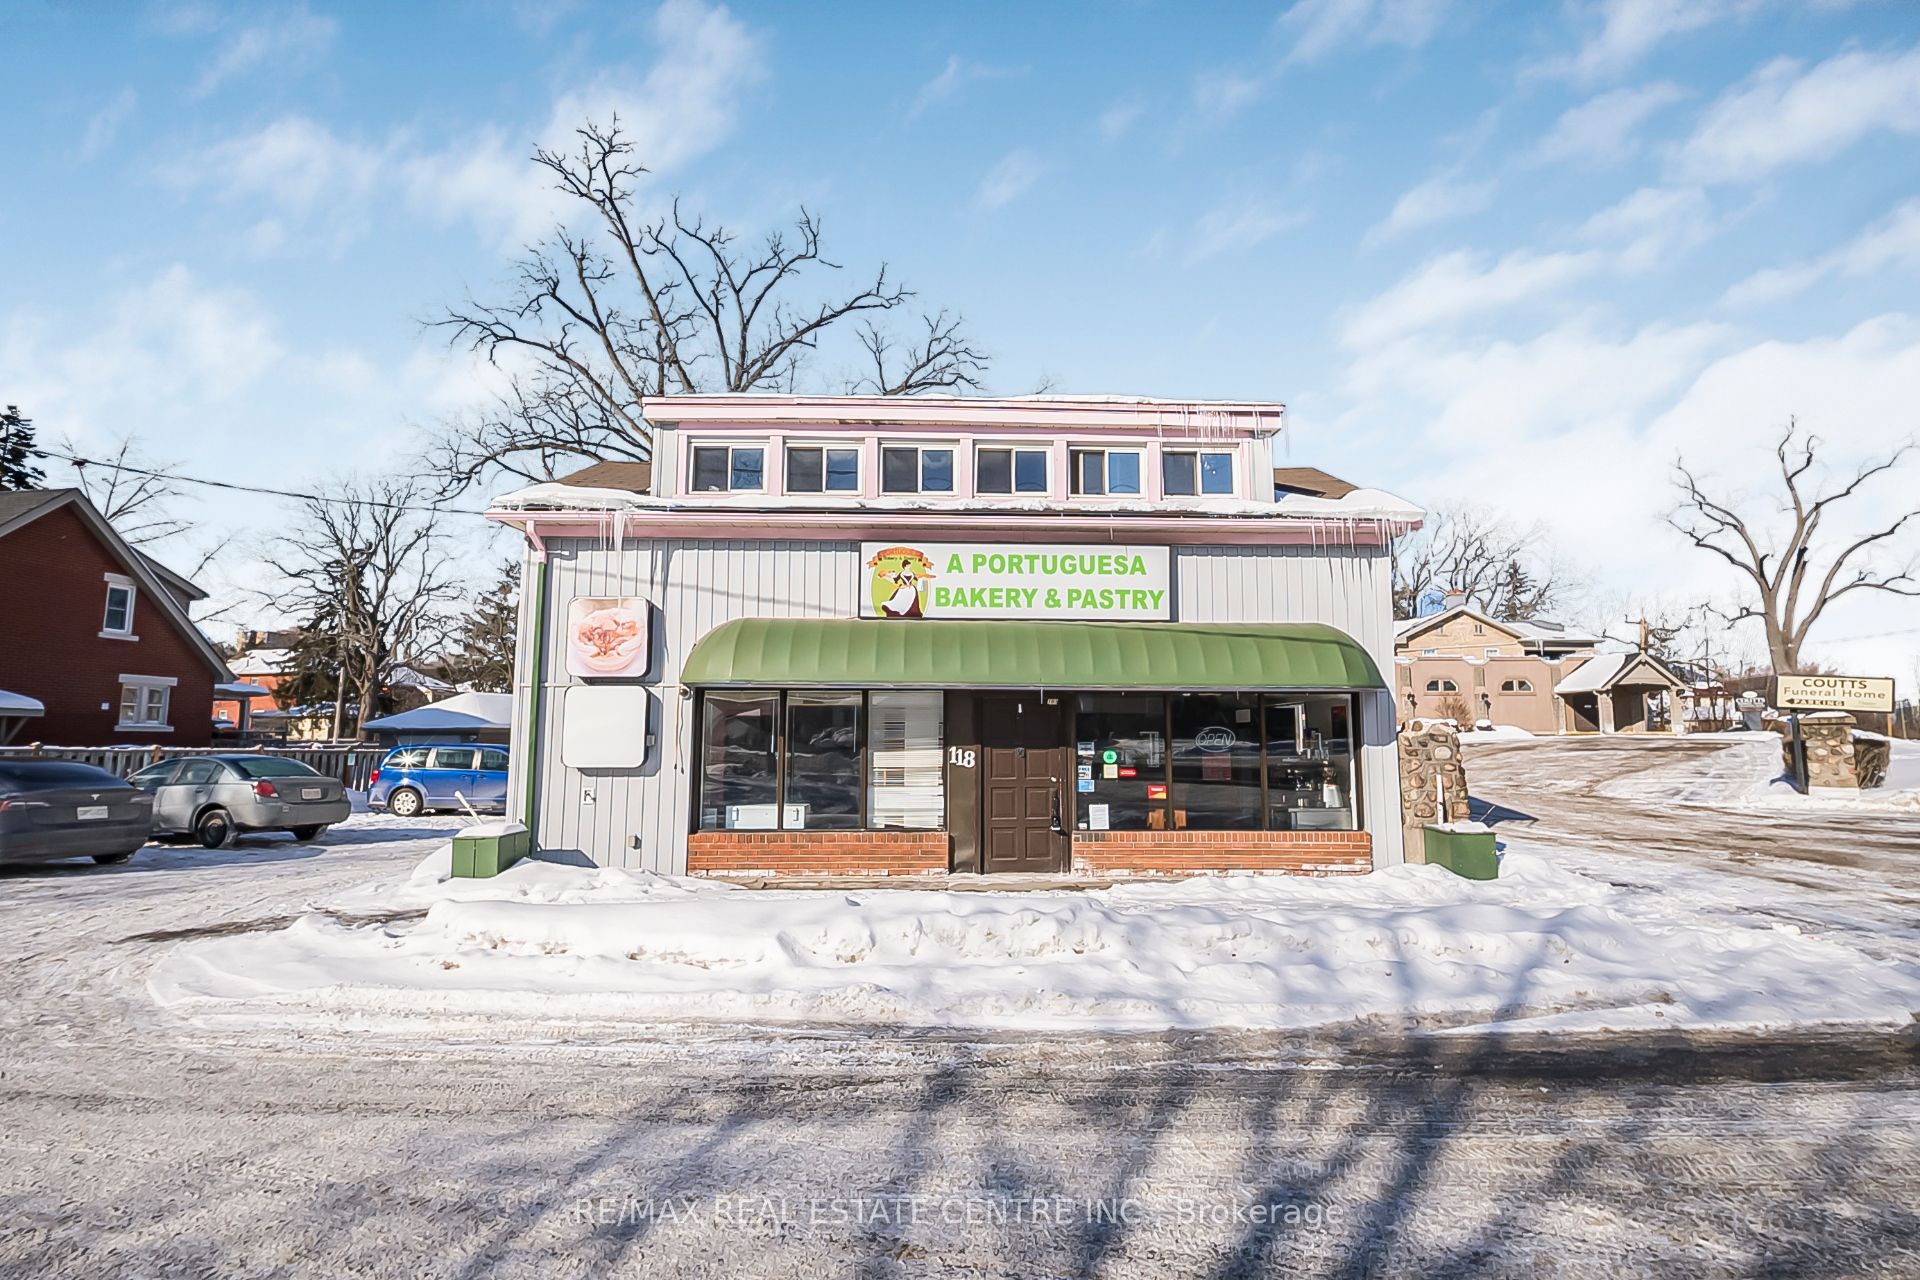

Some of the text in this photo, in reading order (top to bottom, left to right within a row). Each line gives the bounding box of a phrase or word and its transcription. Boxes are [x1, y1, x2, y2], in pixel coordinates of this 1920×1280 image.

[946, 553, 1147, 575] A PORTUGUESA
[935, 587, 1165, 610] BAKERY & PASTRY
[1802, 678, 1868, 689] COUTTS
[1783, 686, 1886, 699] Funeral Home
[1198, 733, 1232, 746] OPEN
[949, 745, 975, 768] 118
